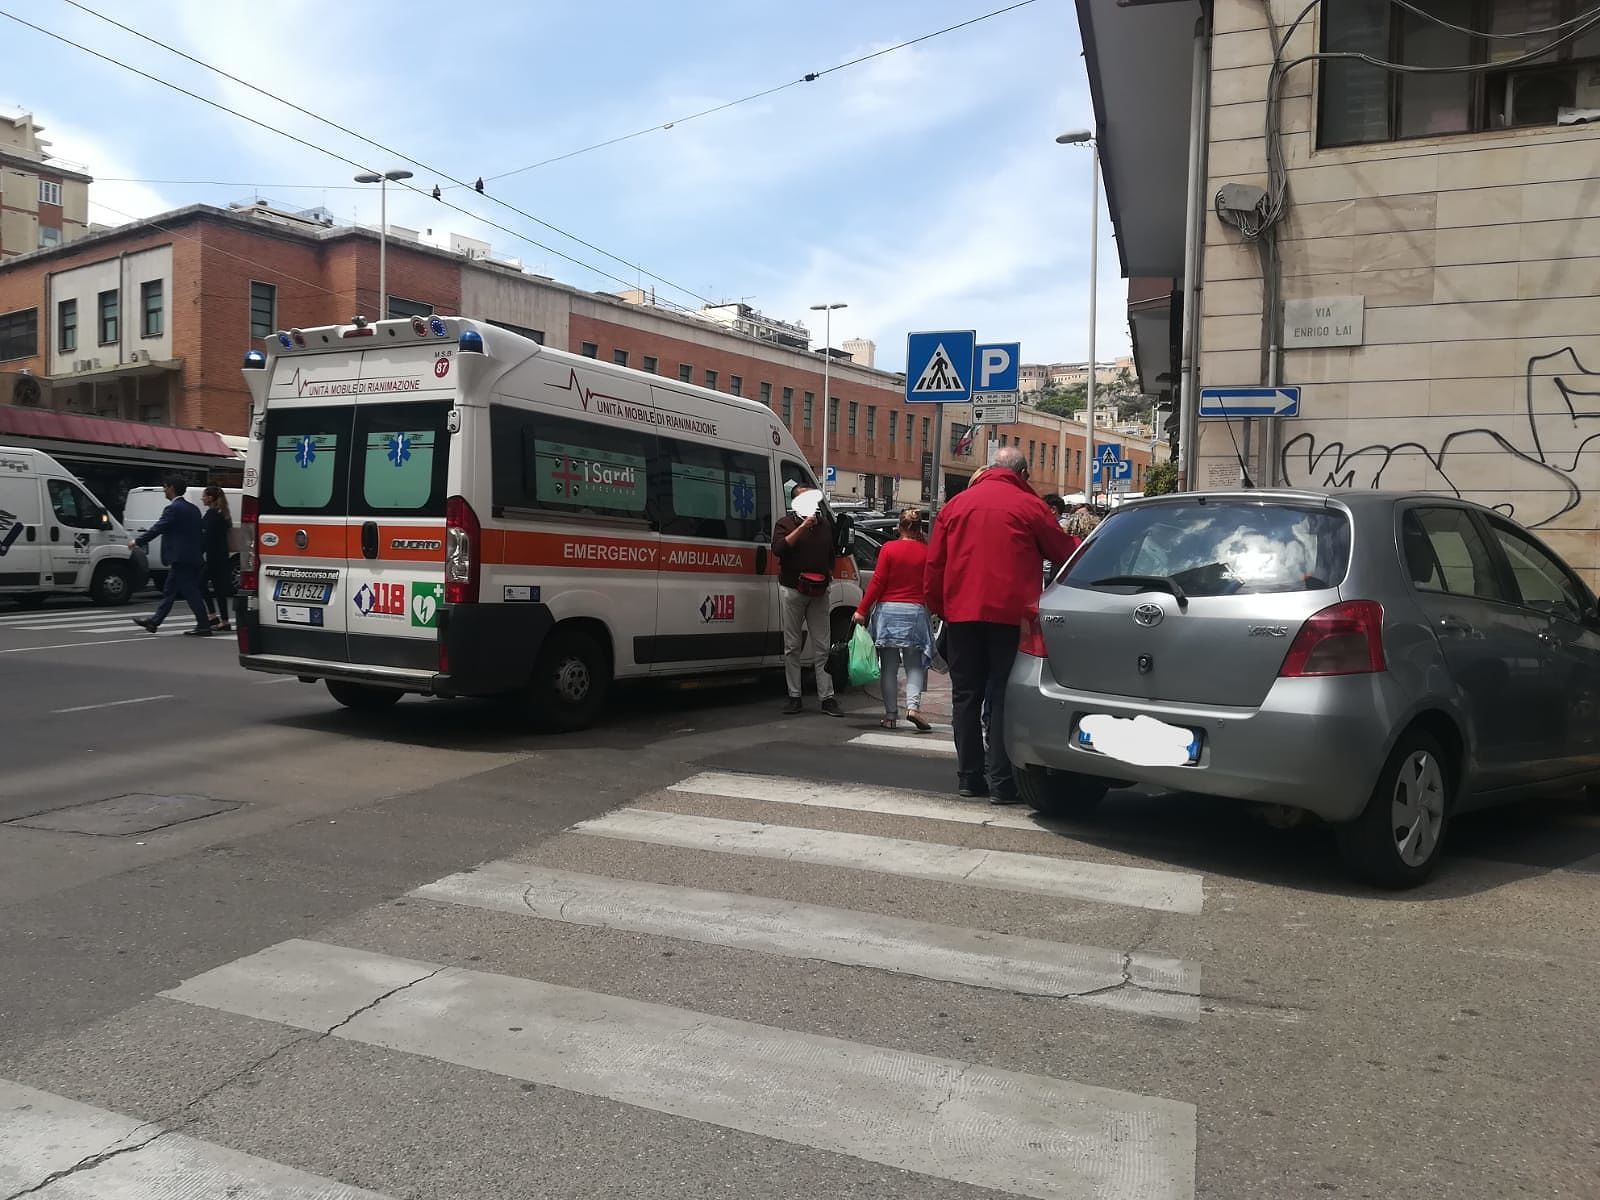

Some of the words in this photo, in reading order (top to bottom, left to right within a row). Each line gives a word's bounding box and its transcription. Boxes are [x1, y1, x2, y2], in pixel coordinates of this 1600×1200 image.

[1315, 307, 1331, 318] VIA
[1294, 326, 1329, 338] ENRICO
[436, 361, 449, 374] 87
[981, 348, 1010, 387] P
[330, 383, 358, 395] MOBILE
[358, 382, 367, 393] DI
[367, 379, 421, 393] RIANIMAZIONE
[624, 406, 656, 424] MOBILE
[656, 413, 665, 425] DI
[665, 414, 718, 436] RIANIMAZIONE
[1115, 461, 1129, 478] P
[563, 543, 657, 562] EMERGENCY
[668, 553, 743, 568] AMBULANZA
[280, 583, 293, 597] EK
[295, 583, 325, 599] 815ZZ
[373, 582, 405, 614] 118
[713, 595, 735, 620] 118
